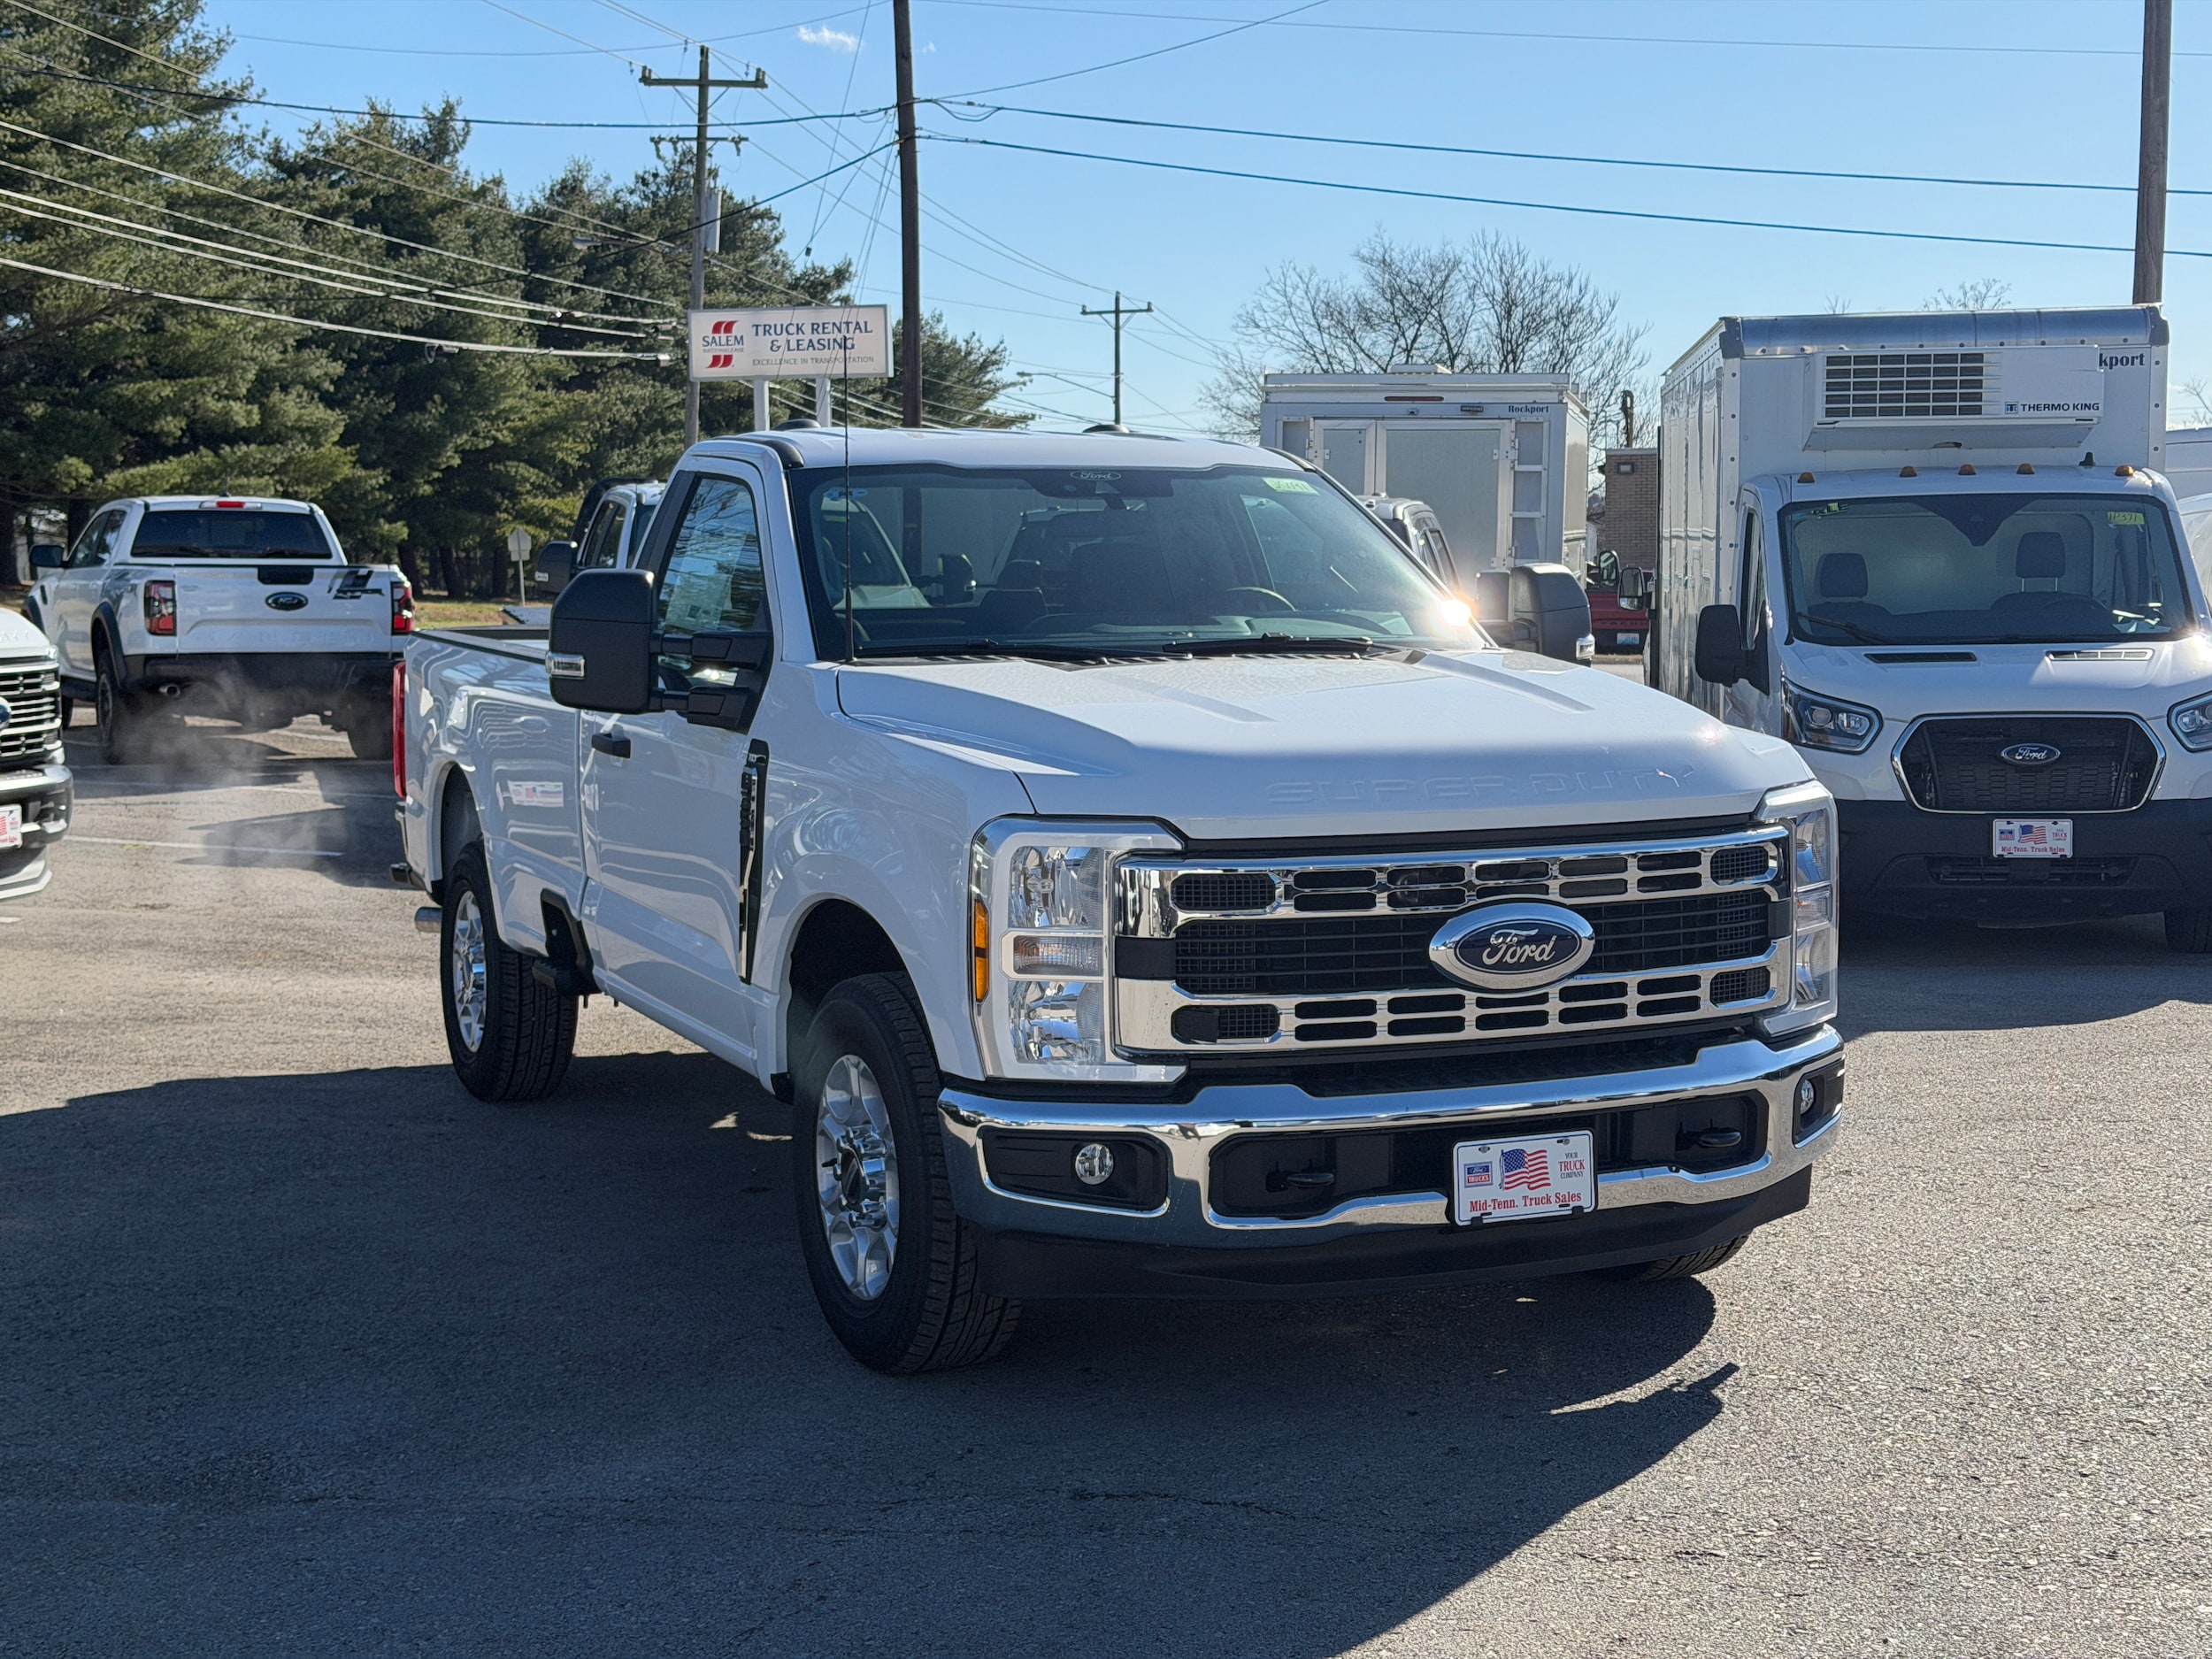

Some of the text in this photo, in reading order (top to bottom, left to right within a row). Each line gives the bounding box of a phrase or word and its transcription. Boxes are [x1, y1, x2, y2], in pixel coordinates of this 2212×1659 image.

[752, 320, 873, 336] TRUCK RENTAL
[702, 334, 745, 348] SALEM
[770, 337, 856, 352] & LEASING
[752, 357, 798, 366] EXCELLENCE
[1508, 404, 1549, 415] Rockport
[2020, 403, 2070, 412] THERMO
[2072, 403, 2101, 411] KING
[1080, 471, 1113, 480] Ford
[2015, 746, 2048, 760] Ford
[1267, 764, 1694, 804] SUPER DUTY
[1482, 929, 1558, 965] Ford
[1558, 1159, 1586, 1172] TRUCK
[1468, 1174, 1490, 1184] TRUCKS
[1560, 1171, 1585, 1179] COMPANY
[1469, 1191, 1582, 1213] Mid-Tenn. Truck Sales
